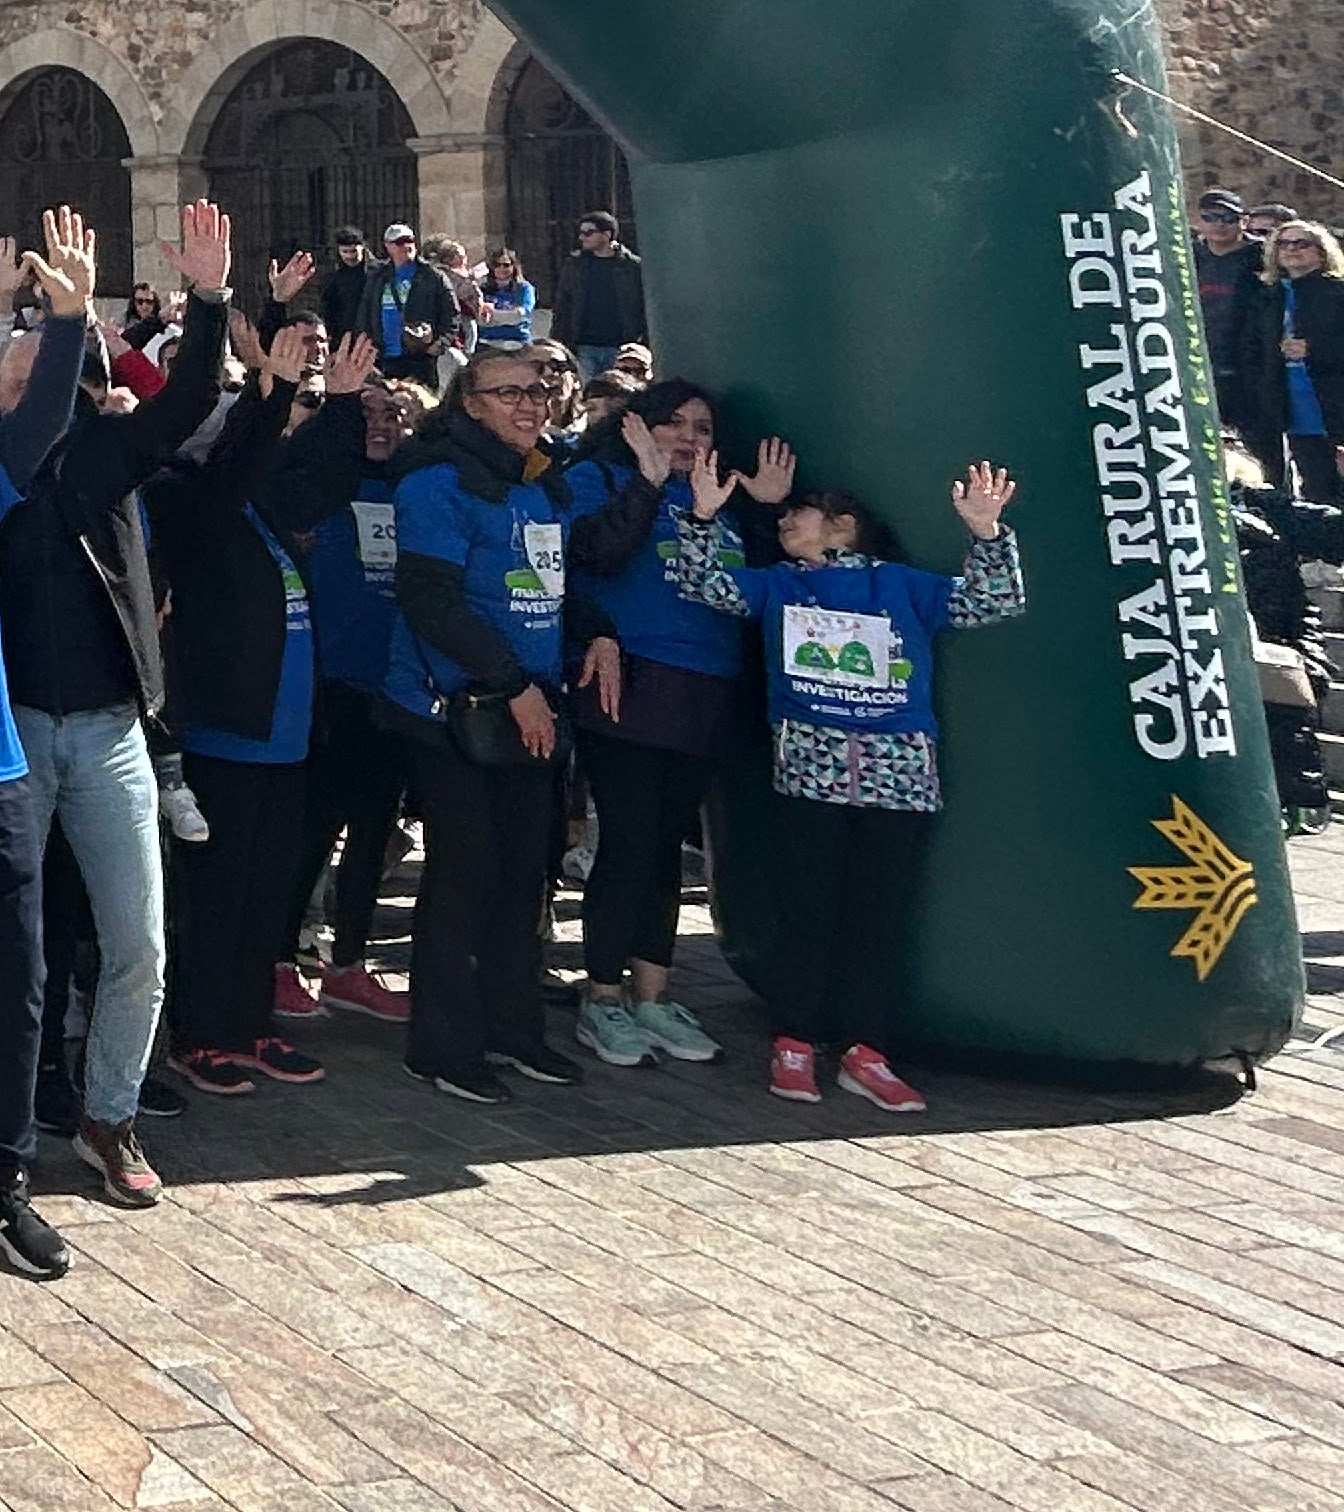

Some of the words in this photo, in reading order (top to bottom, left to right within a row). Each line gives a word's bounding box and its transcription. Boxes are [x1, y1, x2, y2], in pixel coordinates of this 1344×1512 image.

[1060, 210, 1123, 311] DE
[1080, 321, 1162, 566] RURAL
[1114, 169, 1237, 759] EXTREMADURA
[1118, 577, 1188, 762] CAJA
